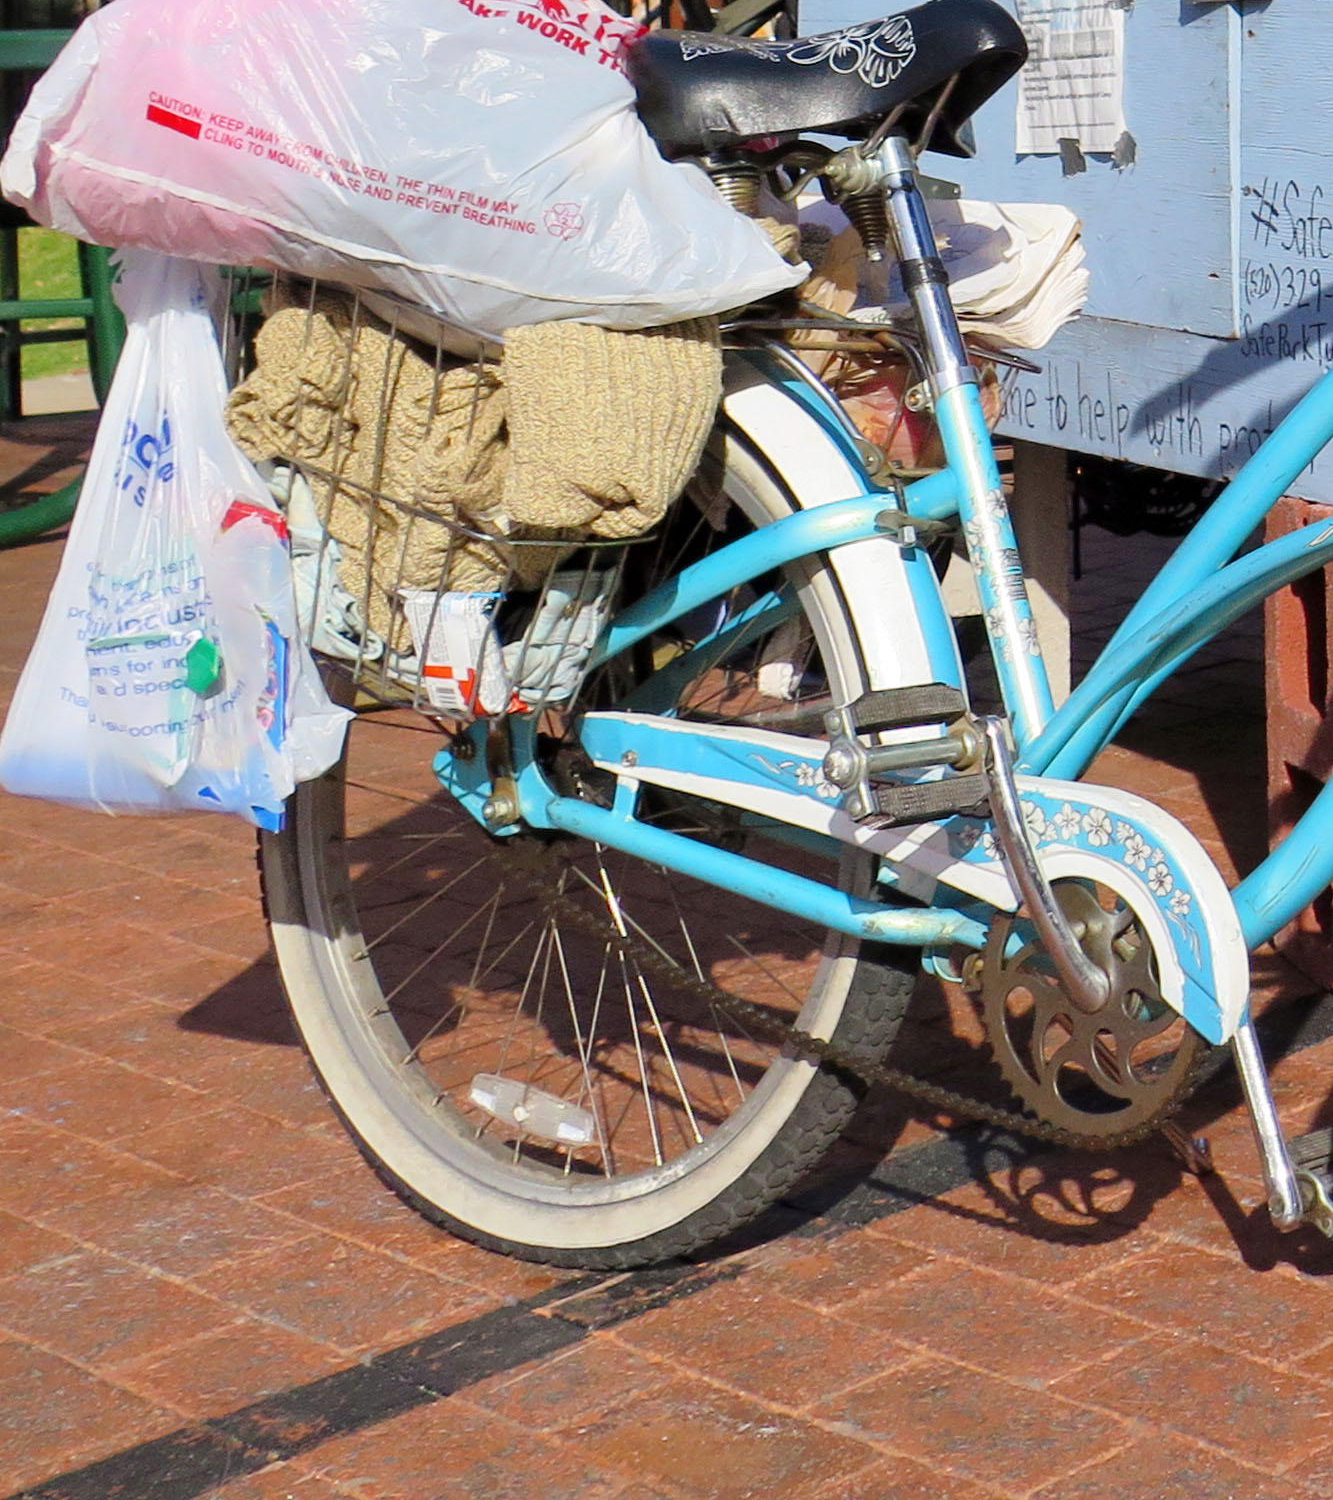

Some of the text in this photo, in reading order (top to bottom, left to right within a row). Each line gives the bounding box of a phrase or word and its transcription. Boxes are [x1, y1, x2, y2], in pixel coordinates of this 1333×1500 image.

[516, 10, 591, 56] WORK
[149, 91, 206, 119] CAUTION:
[208, 112, 244, 132] KEEP
[246, 125, 280, 146] AWAY
[396, 174, 424, 193] THE
[426, 182, 455, 202] THIN
[458, 190, 489, 210] FILM
[491, 199, 519, 215] MAY
[203, 127, 244, 150] CLING
[248, 141, 265, 157] TO
[363, 184, 394, 202] AND
[396, 192, 459, 216] PREVENT
[462, 206, 539, 235] BREATHING.
[1045, 359, 1069, 432] to
[1077, 361, 1131, 456] help
[1143, 382, 1202, 455] with
